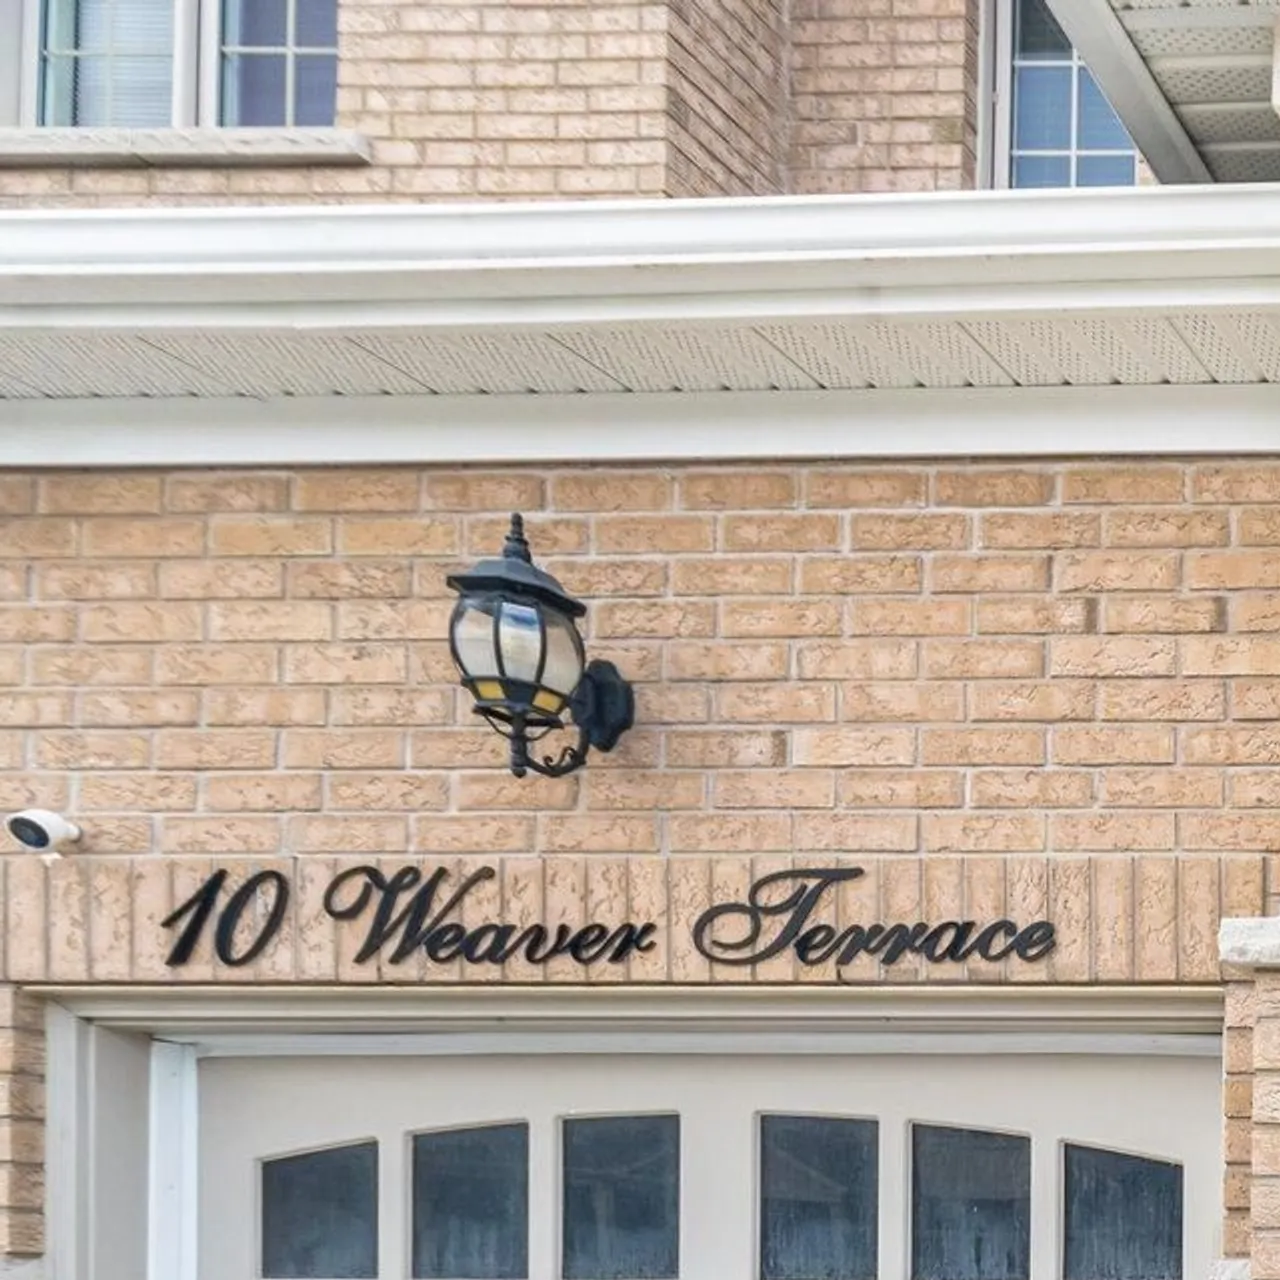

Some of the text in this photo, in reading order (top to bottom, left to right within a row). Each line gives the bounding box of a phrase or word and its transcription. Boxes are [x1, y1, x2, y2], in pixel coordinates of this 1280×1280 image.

[162, 865, 1058, 967] 10 Weaver Terrace
